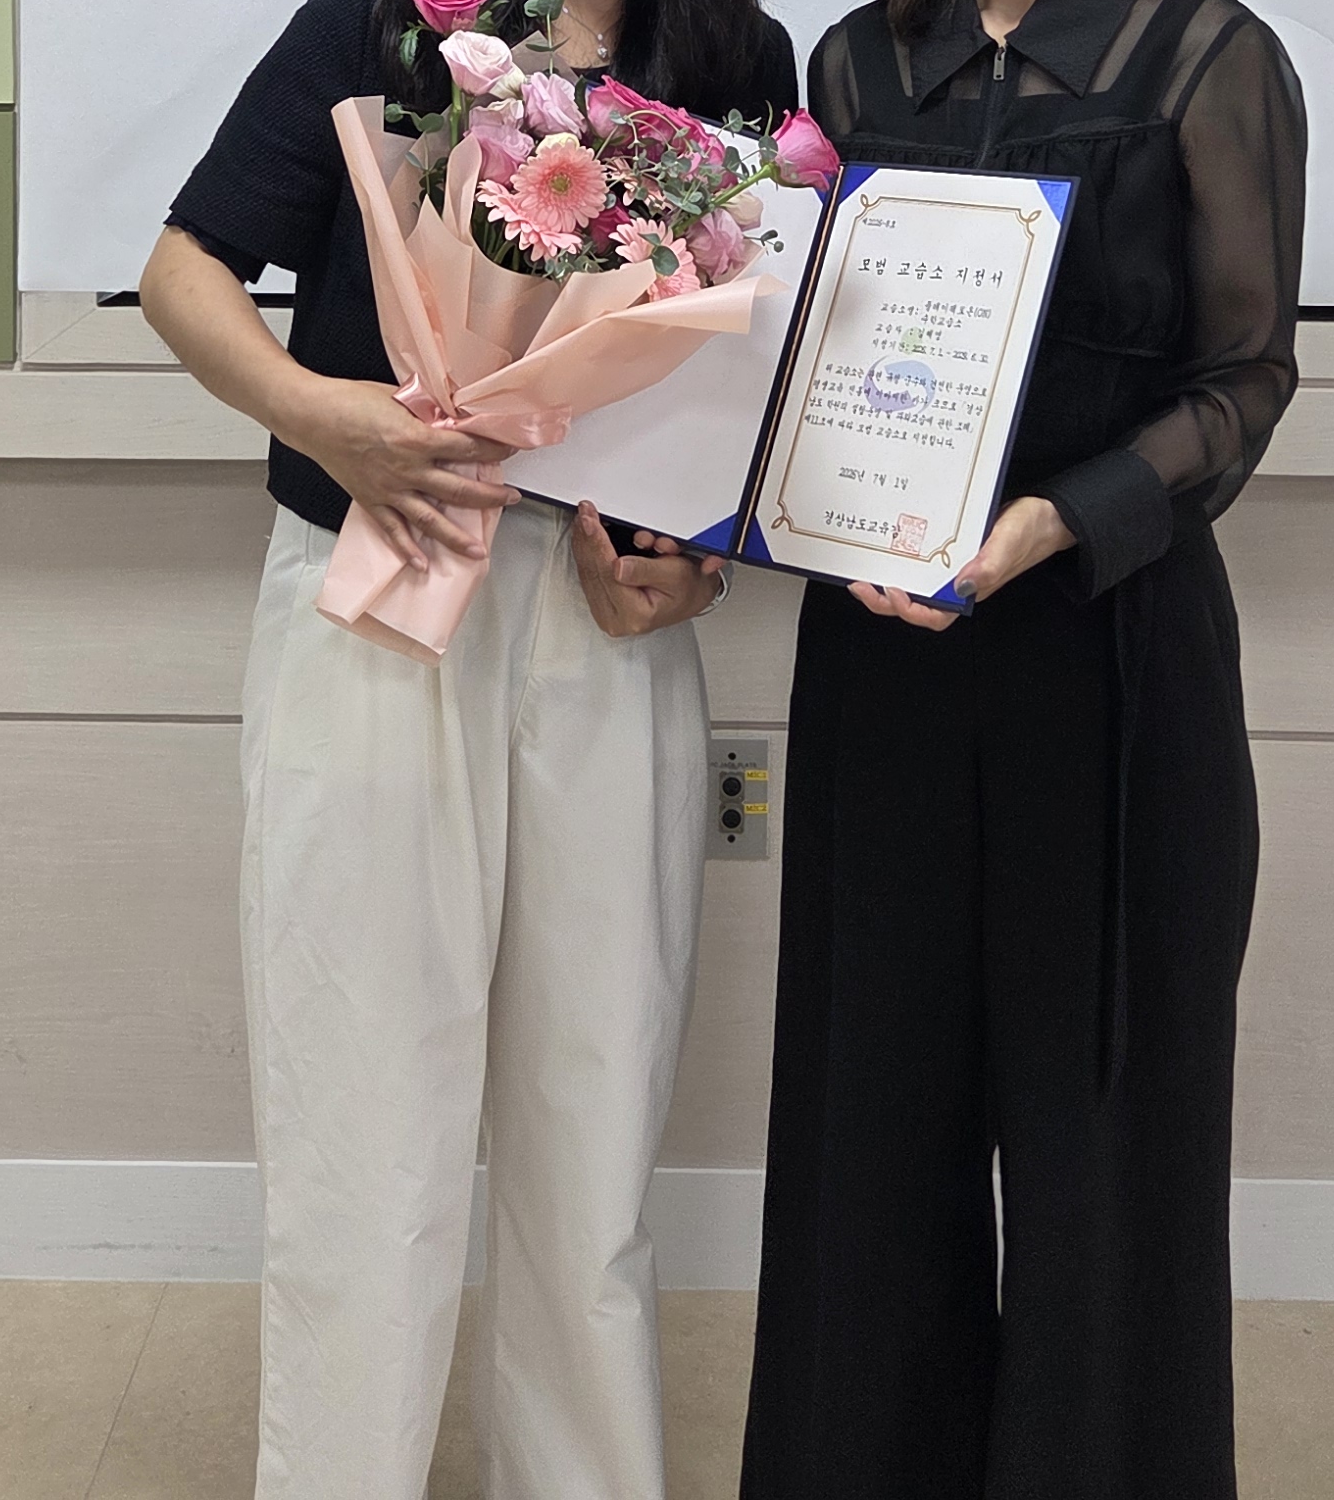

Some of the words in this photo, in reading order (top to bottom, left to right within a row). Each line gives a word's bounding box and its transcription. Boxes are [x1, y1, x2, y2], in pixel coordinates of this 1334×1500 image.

[857, 258, 887, 276] 모범
[897, 262, 943, 280] 교습소
[955, 267, 1003, 288] 지정서
[824, 510, 901, 539] 경상남도교육감
